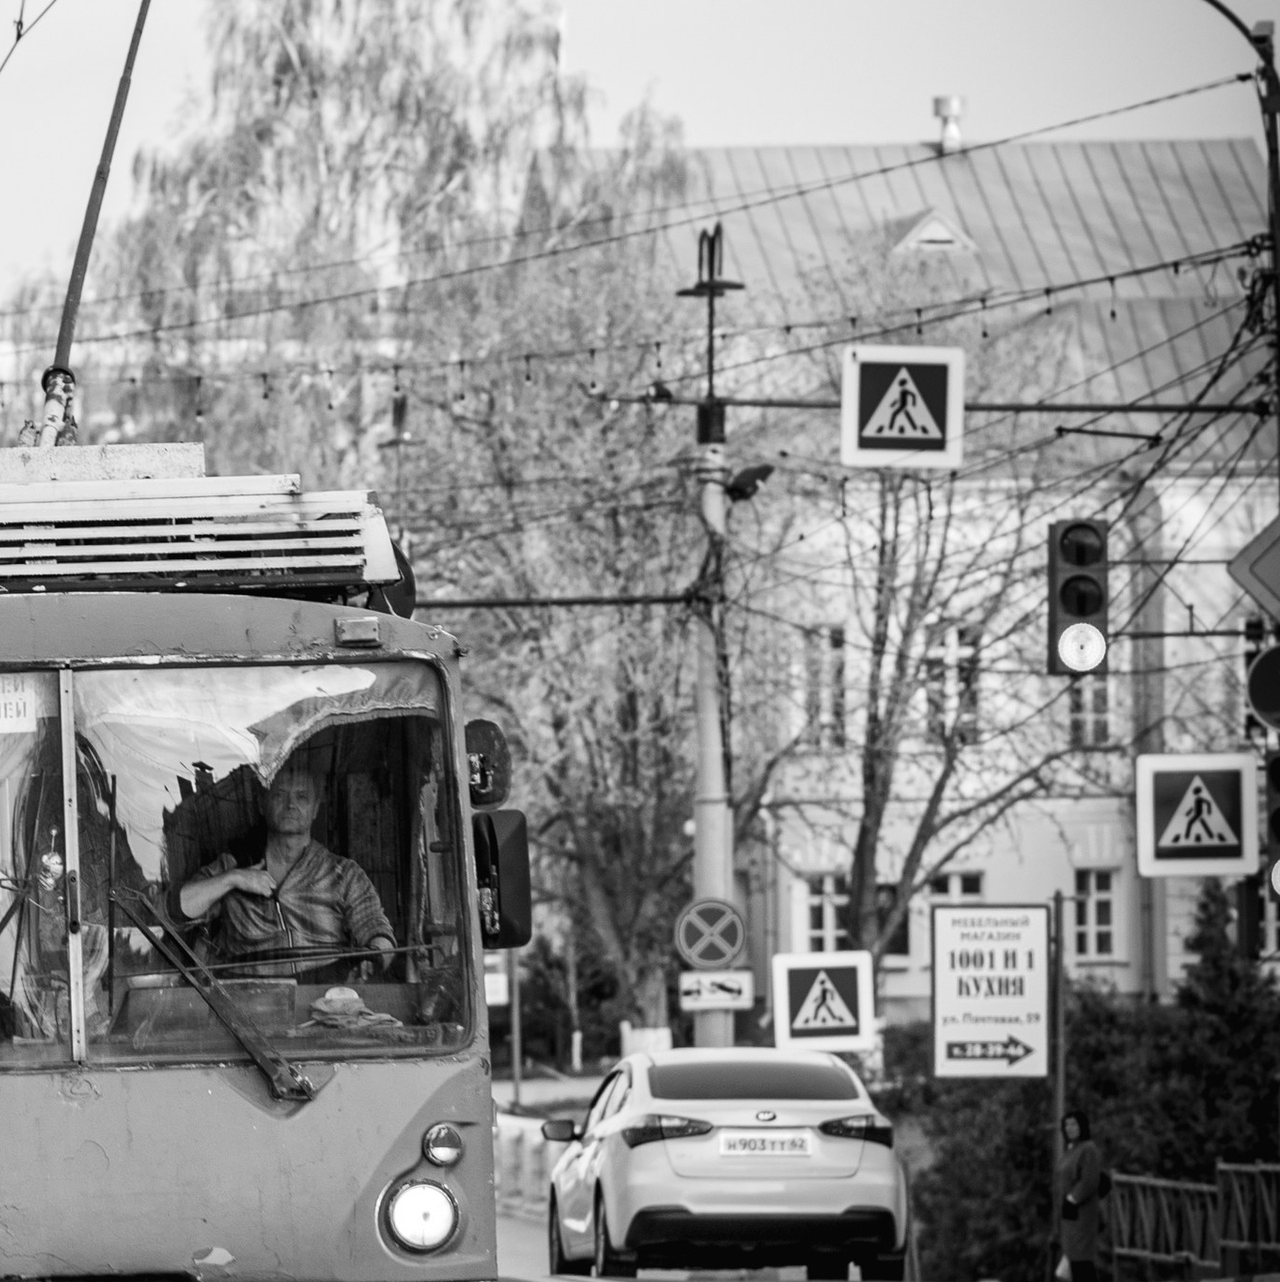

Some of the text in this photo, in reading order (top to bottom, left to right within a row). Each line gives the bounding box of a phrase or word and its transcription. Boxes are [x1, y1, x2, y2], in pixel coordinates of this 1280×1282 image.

[960, 931, 1021, 941] МАГАЗИН
[948, 949, 995, 969] 1001
[1024, 949, 1035, 969] 1
[958, 976, 1024, 997] КУХНЯ
